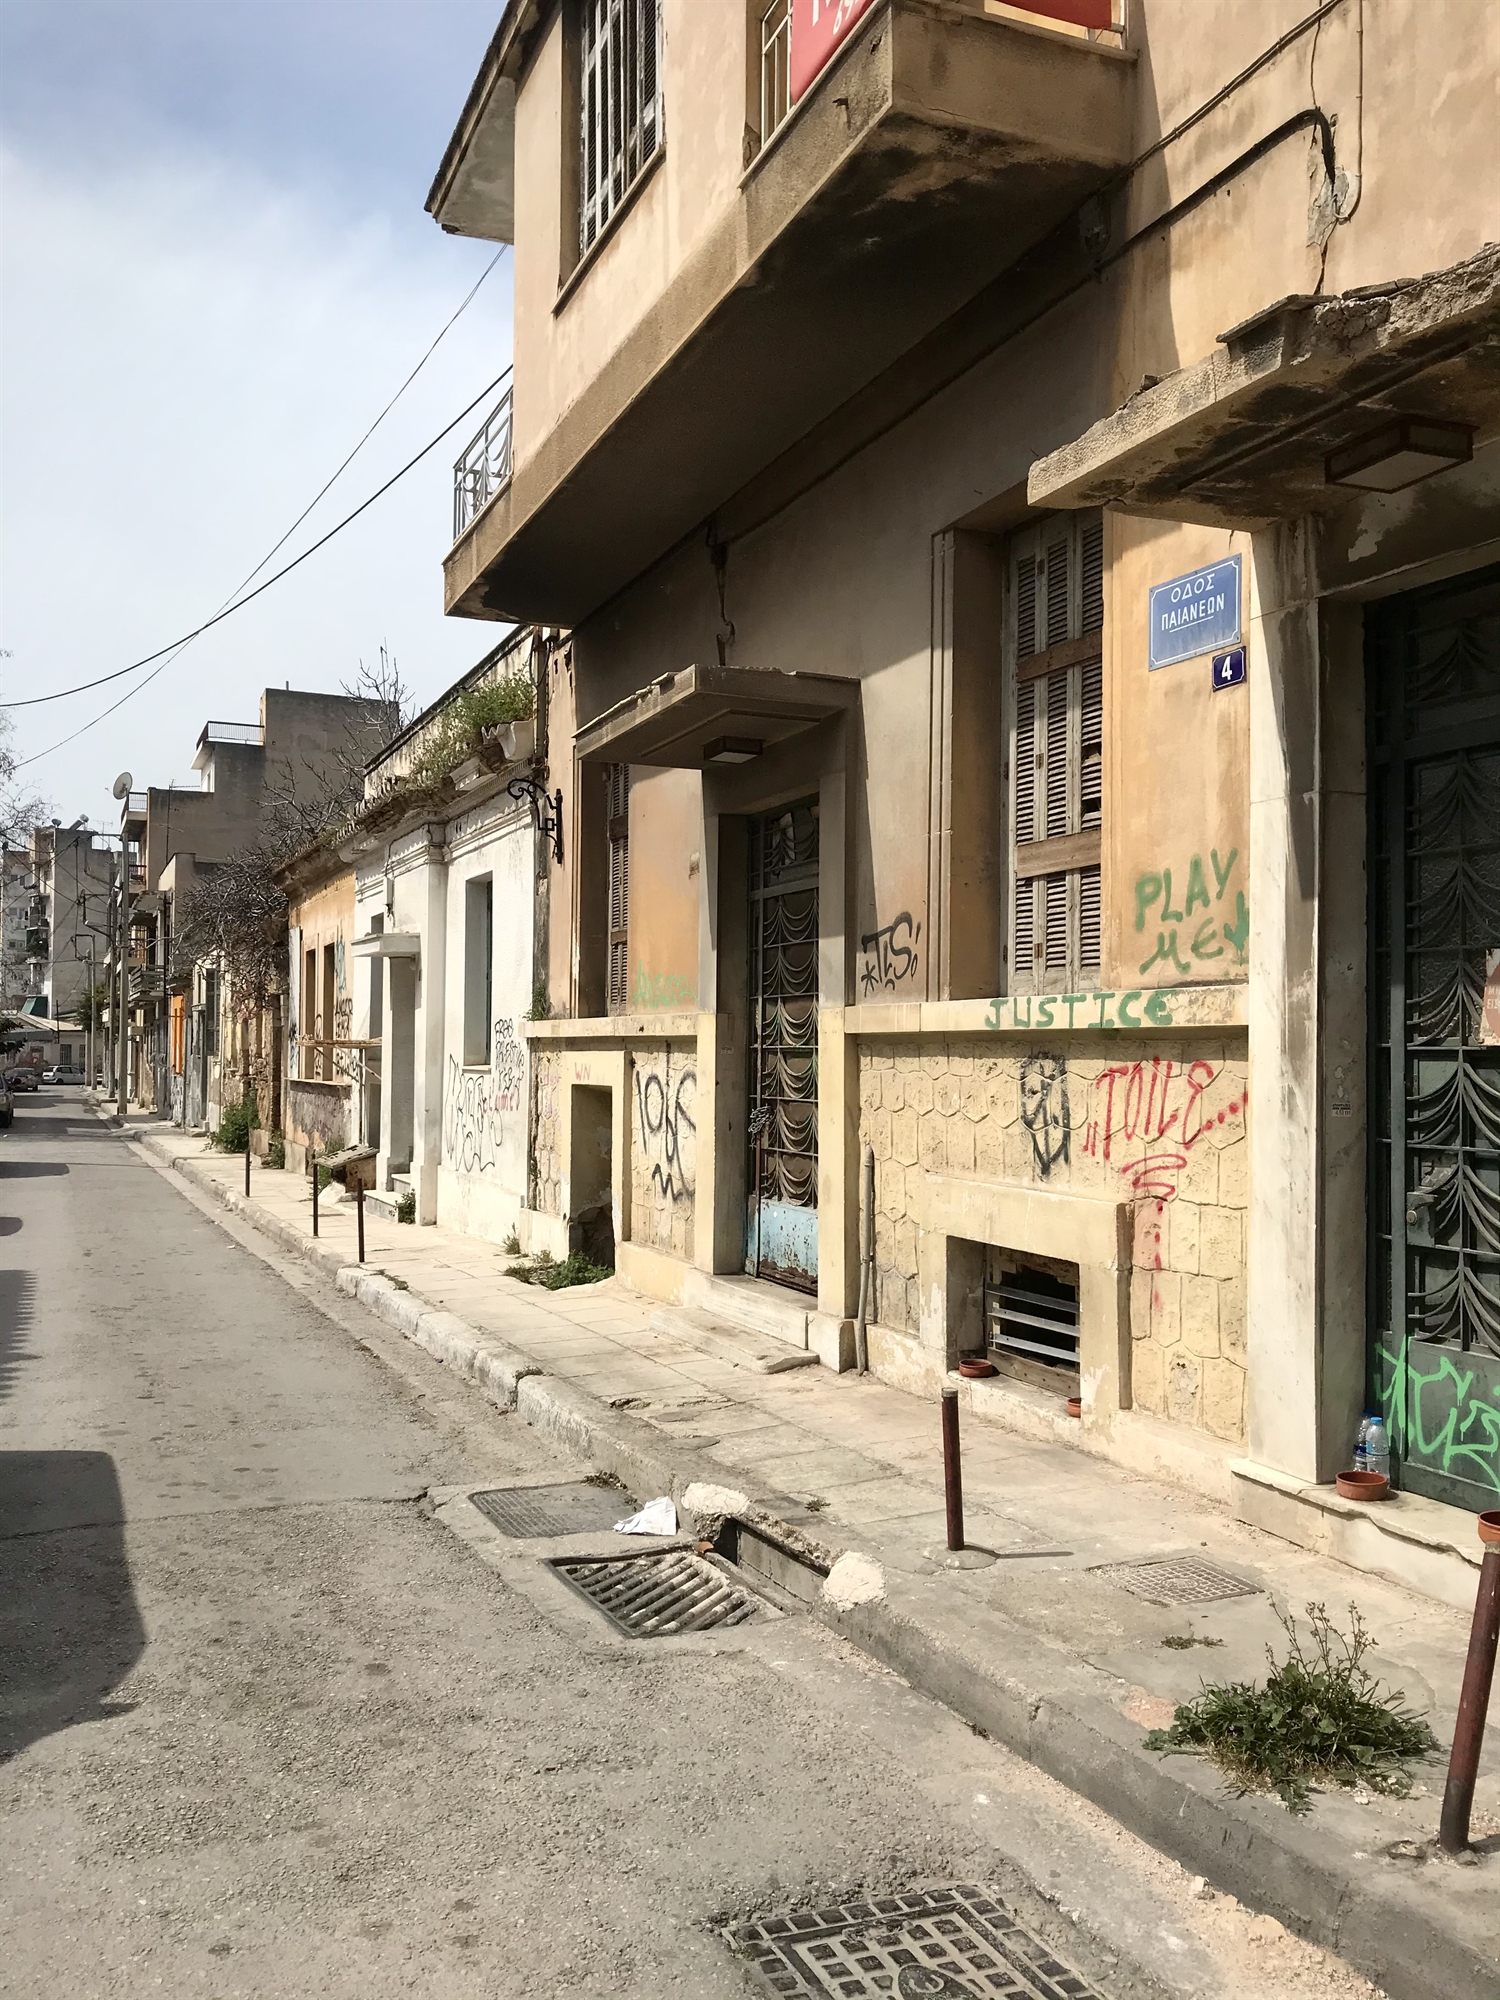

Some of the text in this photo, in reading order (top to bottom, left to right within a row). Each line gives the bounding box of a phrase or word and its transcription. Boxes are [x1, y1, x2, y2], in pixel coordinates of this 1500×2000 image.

[1170, 572, 1216, 604] ΟΔΟΣ
[1161, 592, 1225, 631] ΠΑΙΑΝΕΩΝ
[1220, 655, 1233, 681] 4
[1135, 847, 1239, 931] PLAY
